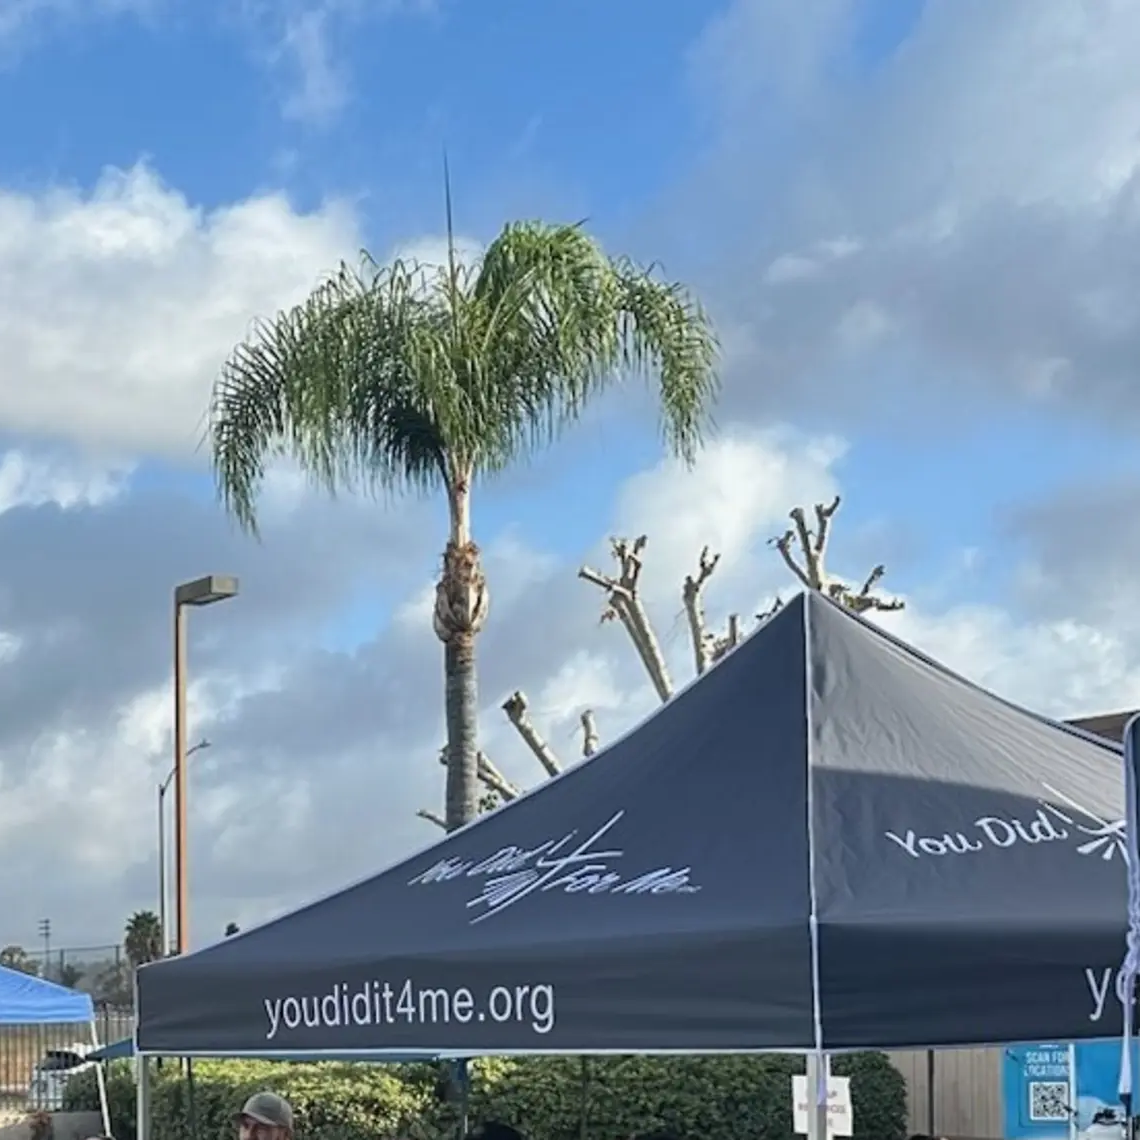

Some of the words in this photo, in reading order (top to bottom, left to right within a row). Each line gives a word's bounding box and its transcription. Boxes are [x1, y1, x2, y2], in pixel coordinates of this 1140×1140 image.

[885, 829, 983, 858] You
[264, 978, 555, 1040] youdidit4me.org
[1025, 1051, 1050, 1063] SCAN
